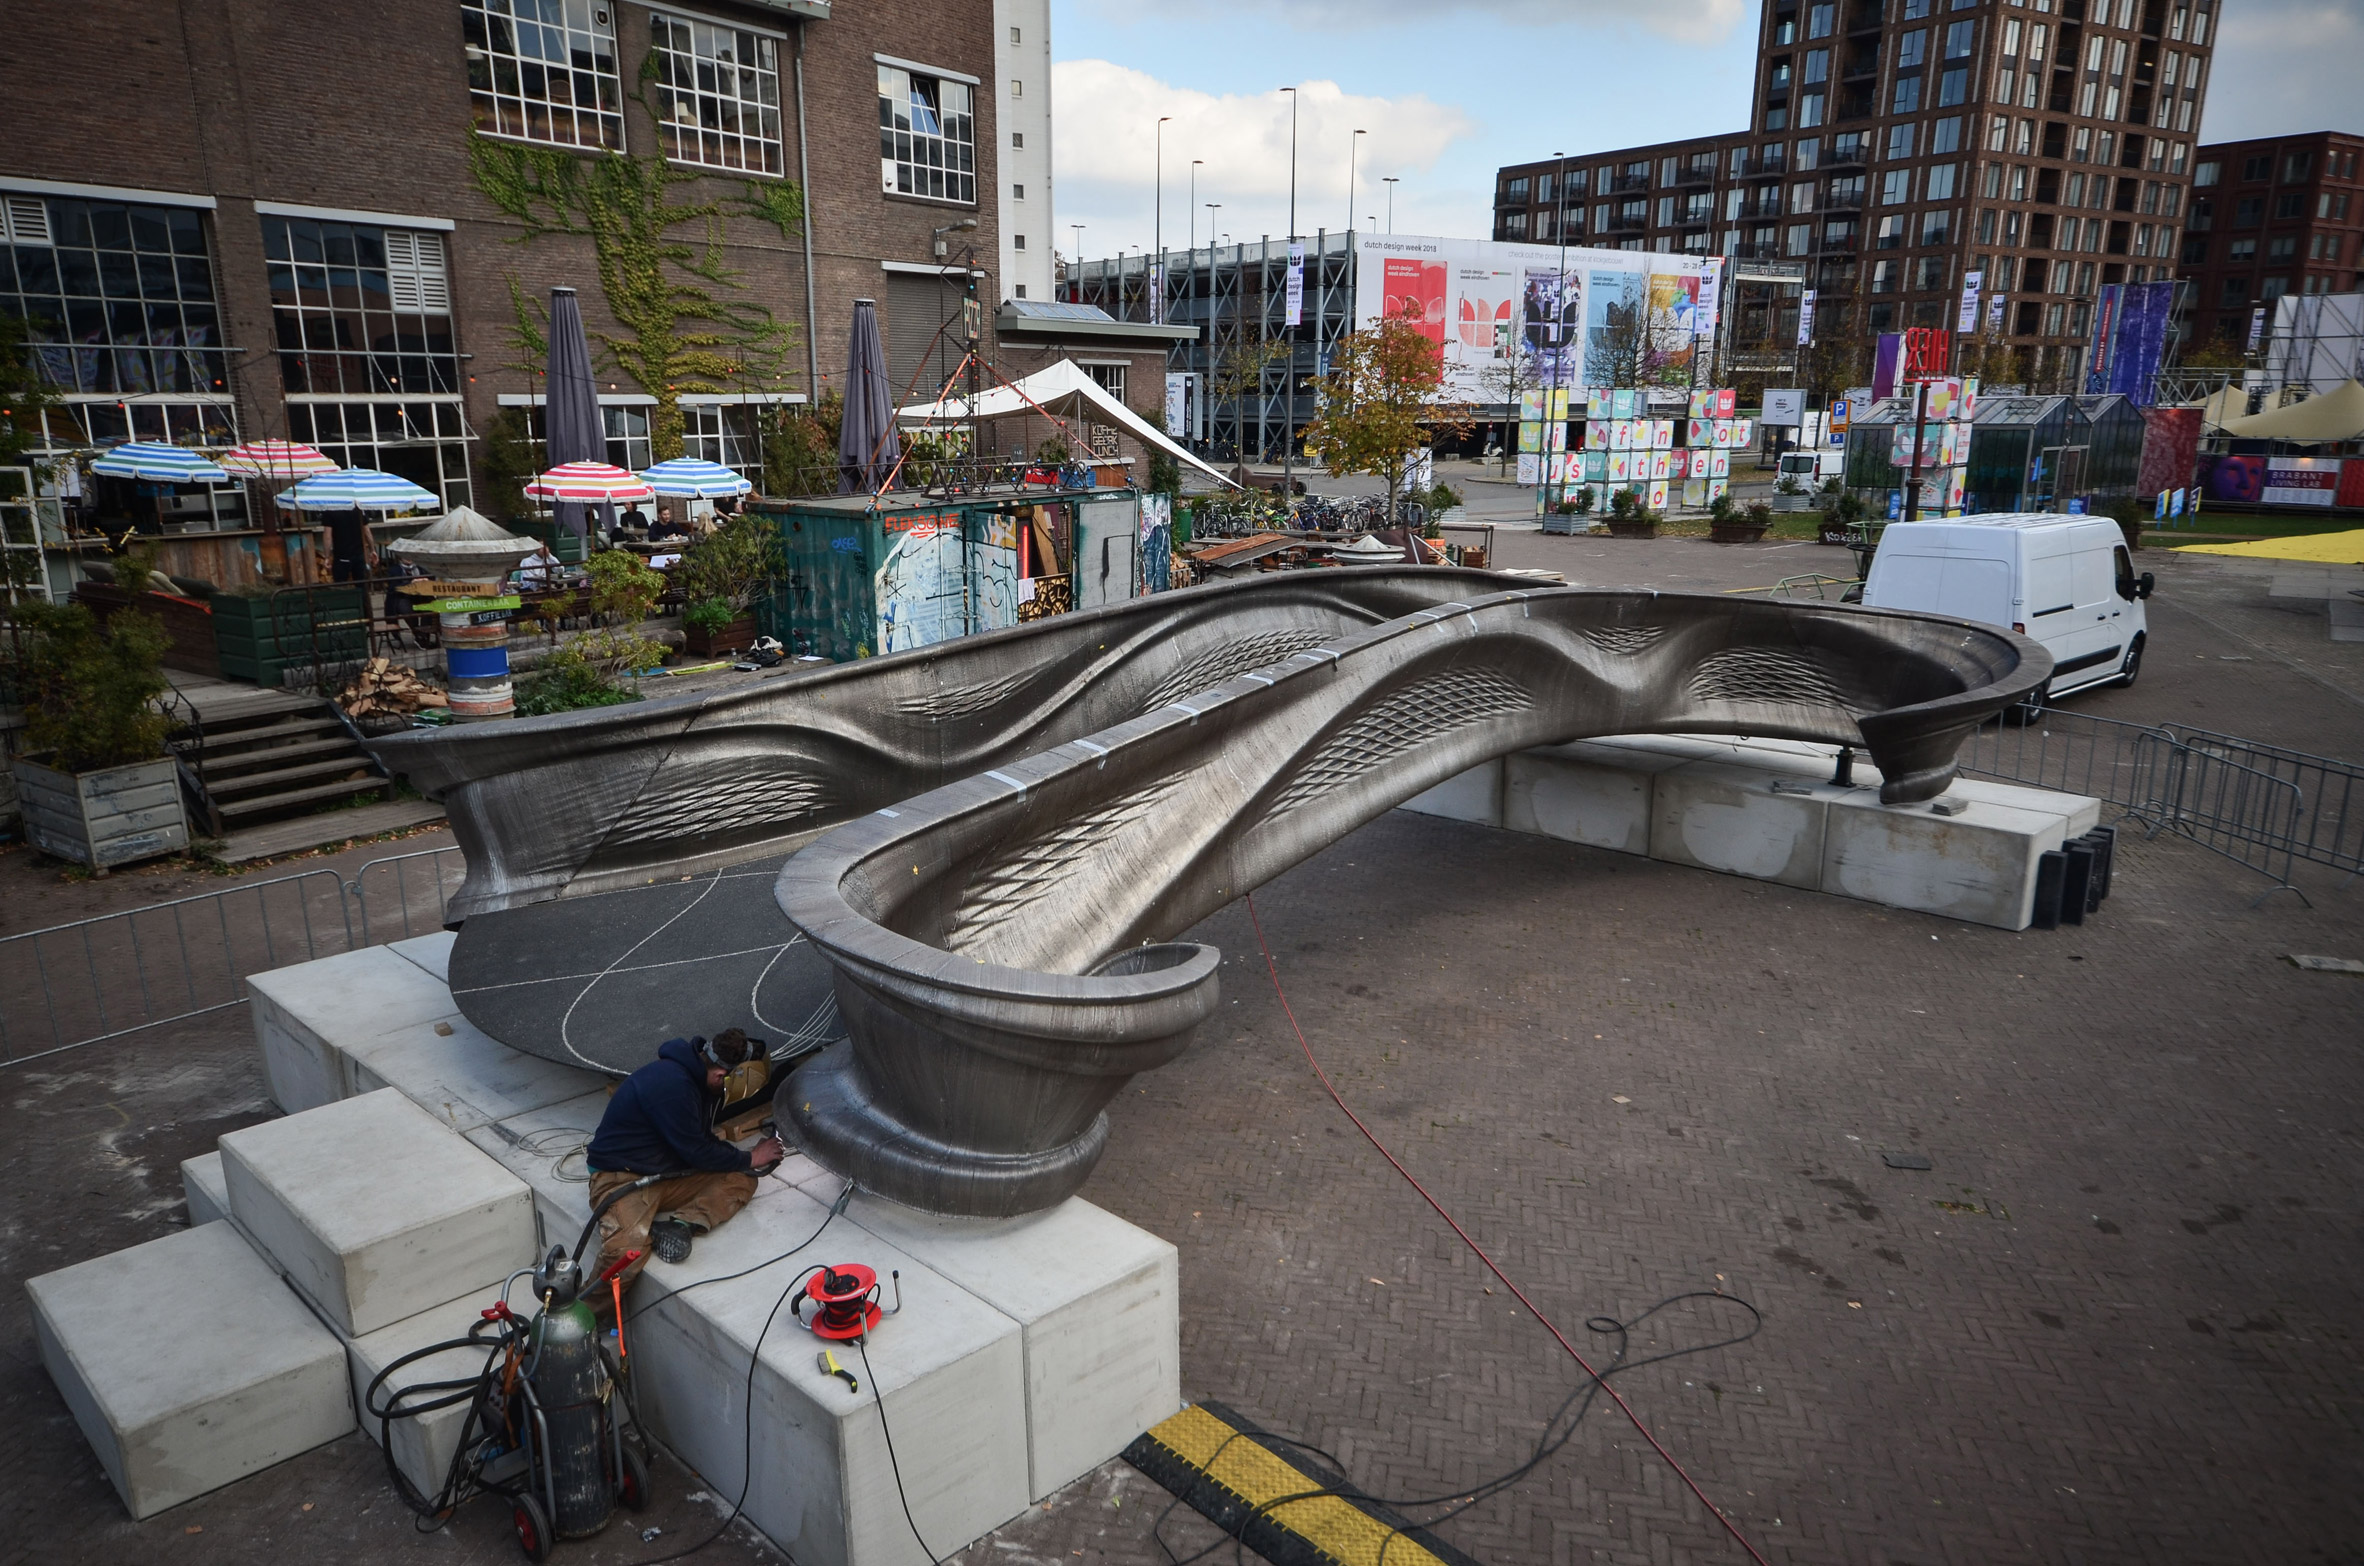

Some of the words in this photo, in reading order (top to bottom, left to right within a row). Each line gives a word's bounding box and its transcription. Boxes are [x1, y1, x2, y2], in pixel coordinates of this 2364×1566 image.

[1364, 240, 1383, 249] dutch
[1384, 241, 1405, 252] design
[1405, 243, 1422, 252] week
[1422, 244, 1437, 253] 2018
[963, 296, 981, 340] PIZZA
[1835, 403, 1844, 415] P
[1834, 434, 1840, 442] P
[2271, 471, 2325, 480] BRABANT
[2269, 480, 2300, 488] LIVING
[2302, 480, 2321, 488] LAB
[432, 585, 481, 593] RESTAURANT
